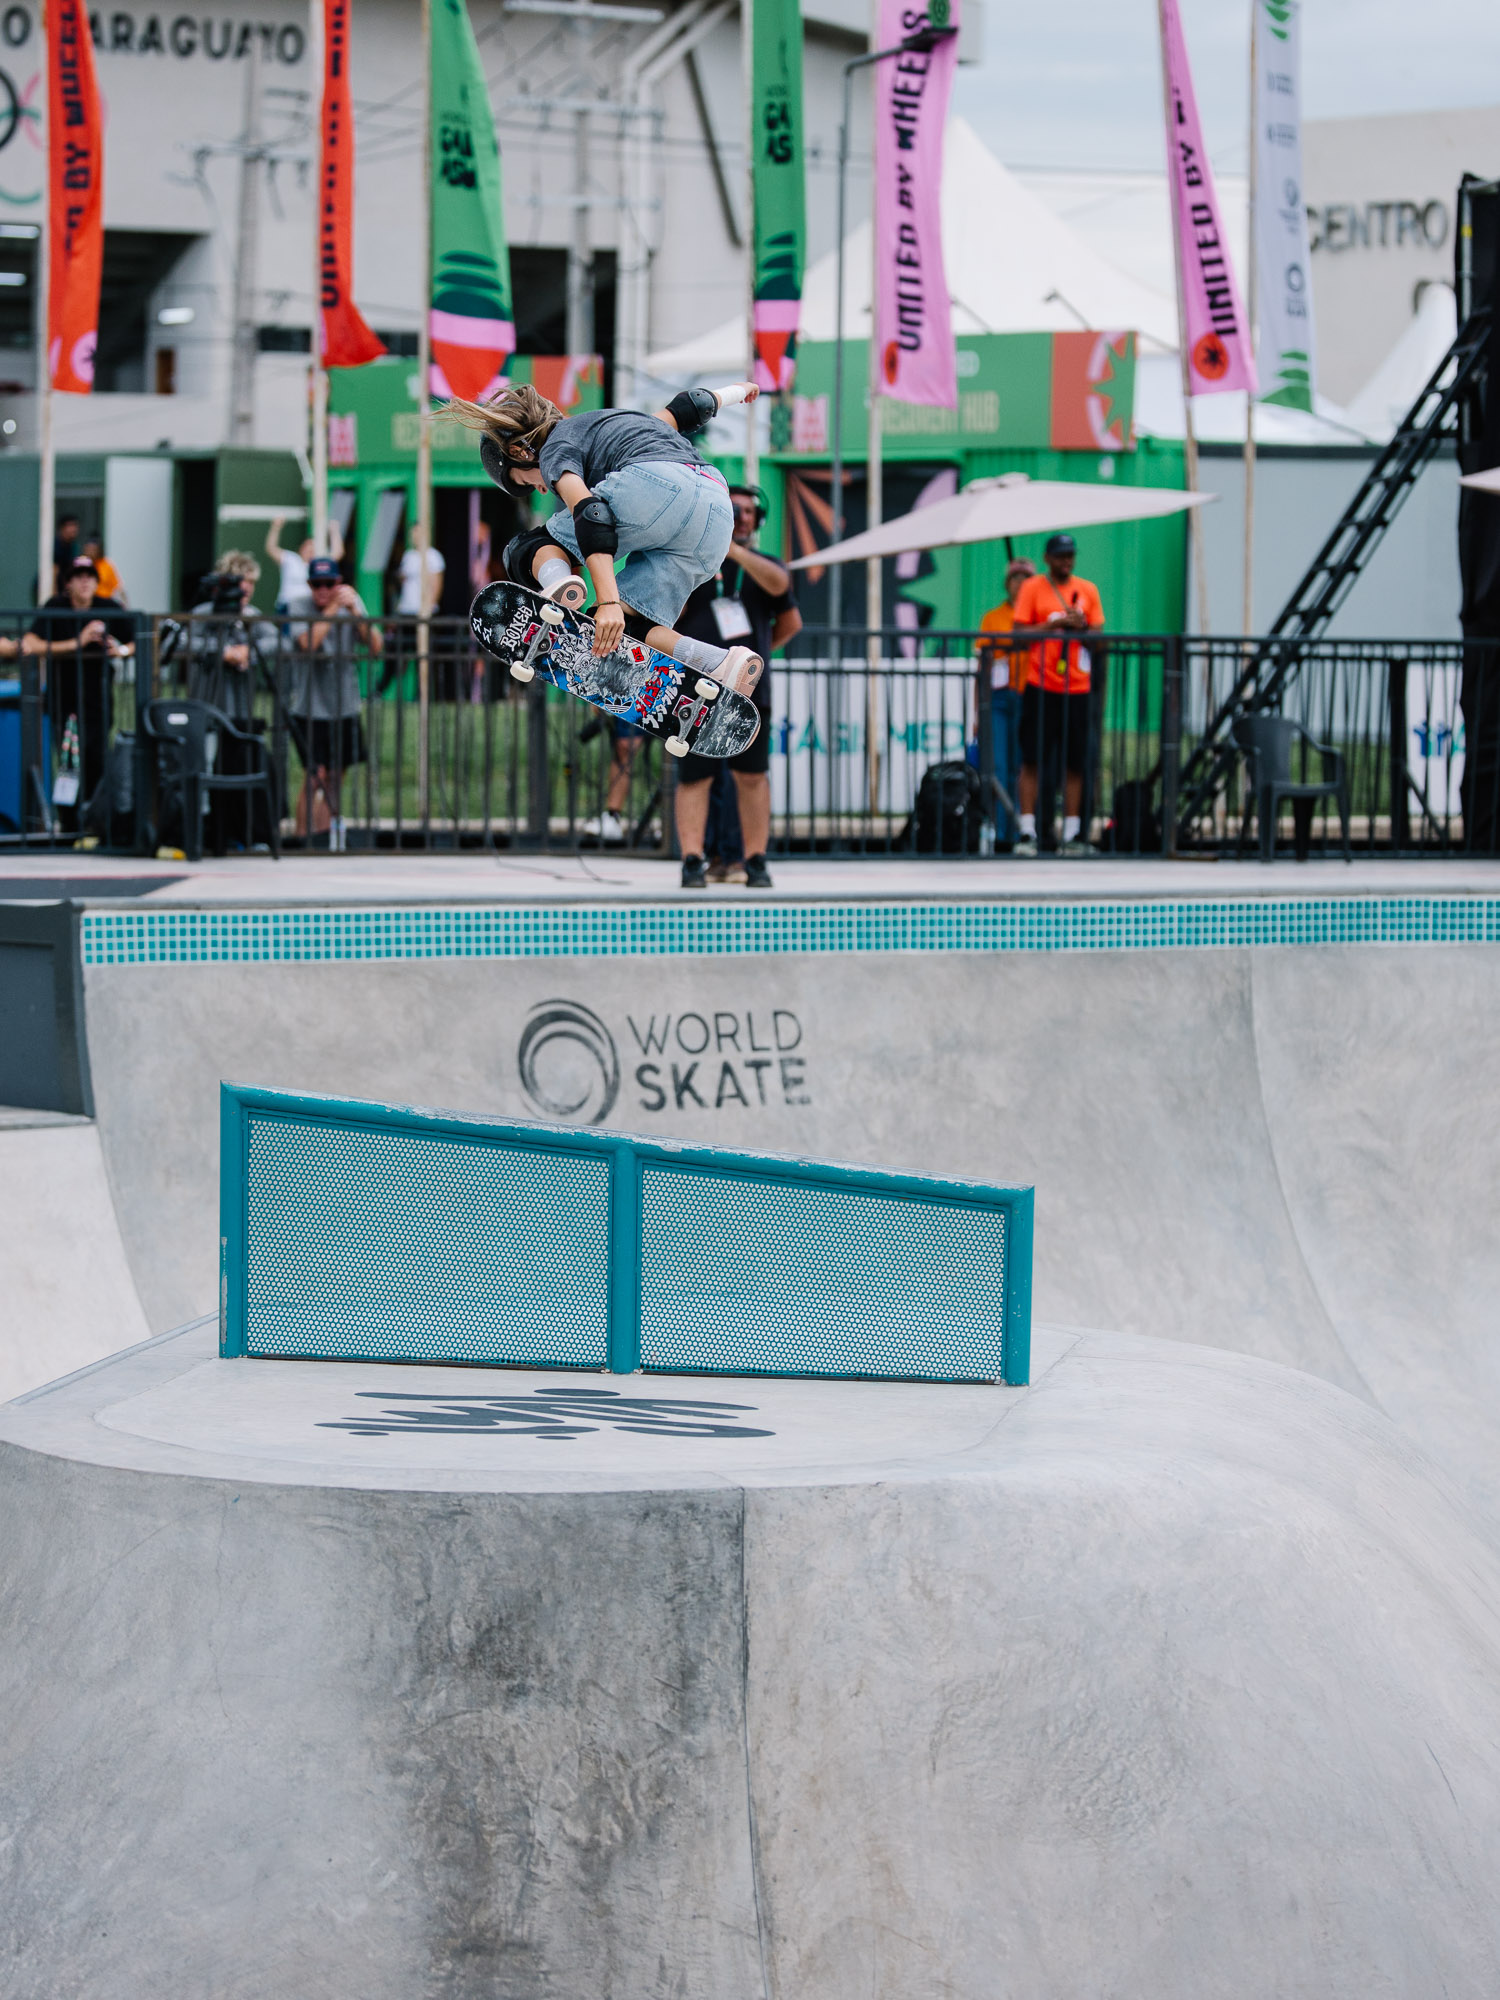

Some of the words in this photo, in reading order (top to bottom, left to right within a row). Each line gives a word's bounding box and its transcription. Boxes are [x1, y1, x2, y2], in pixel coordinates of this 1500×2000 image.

[87, 9, 305, 65] ARAGUAYO
[891, 9, 931, 151] WHEES
[892, 223, 924, 352] UNITED
[500, 604, 533, 653] BONES
[627, 1010, 802, 1056] WORLD
[635, 1057, 812, 1112] SKATE
